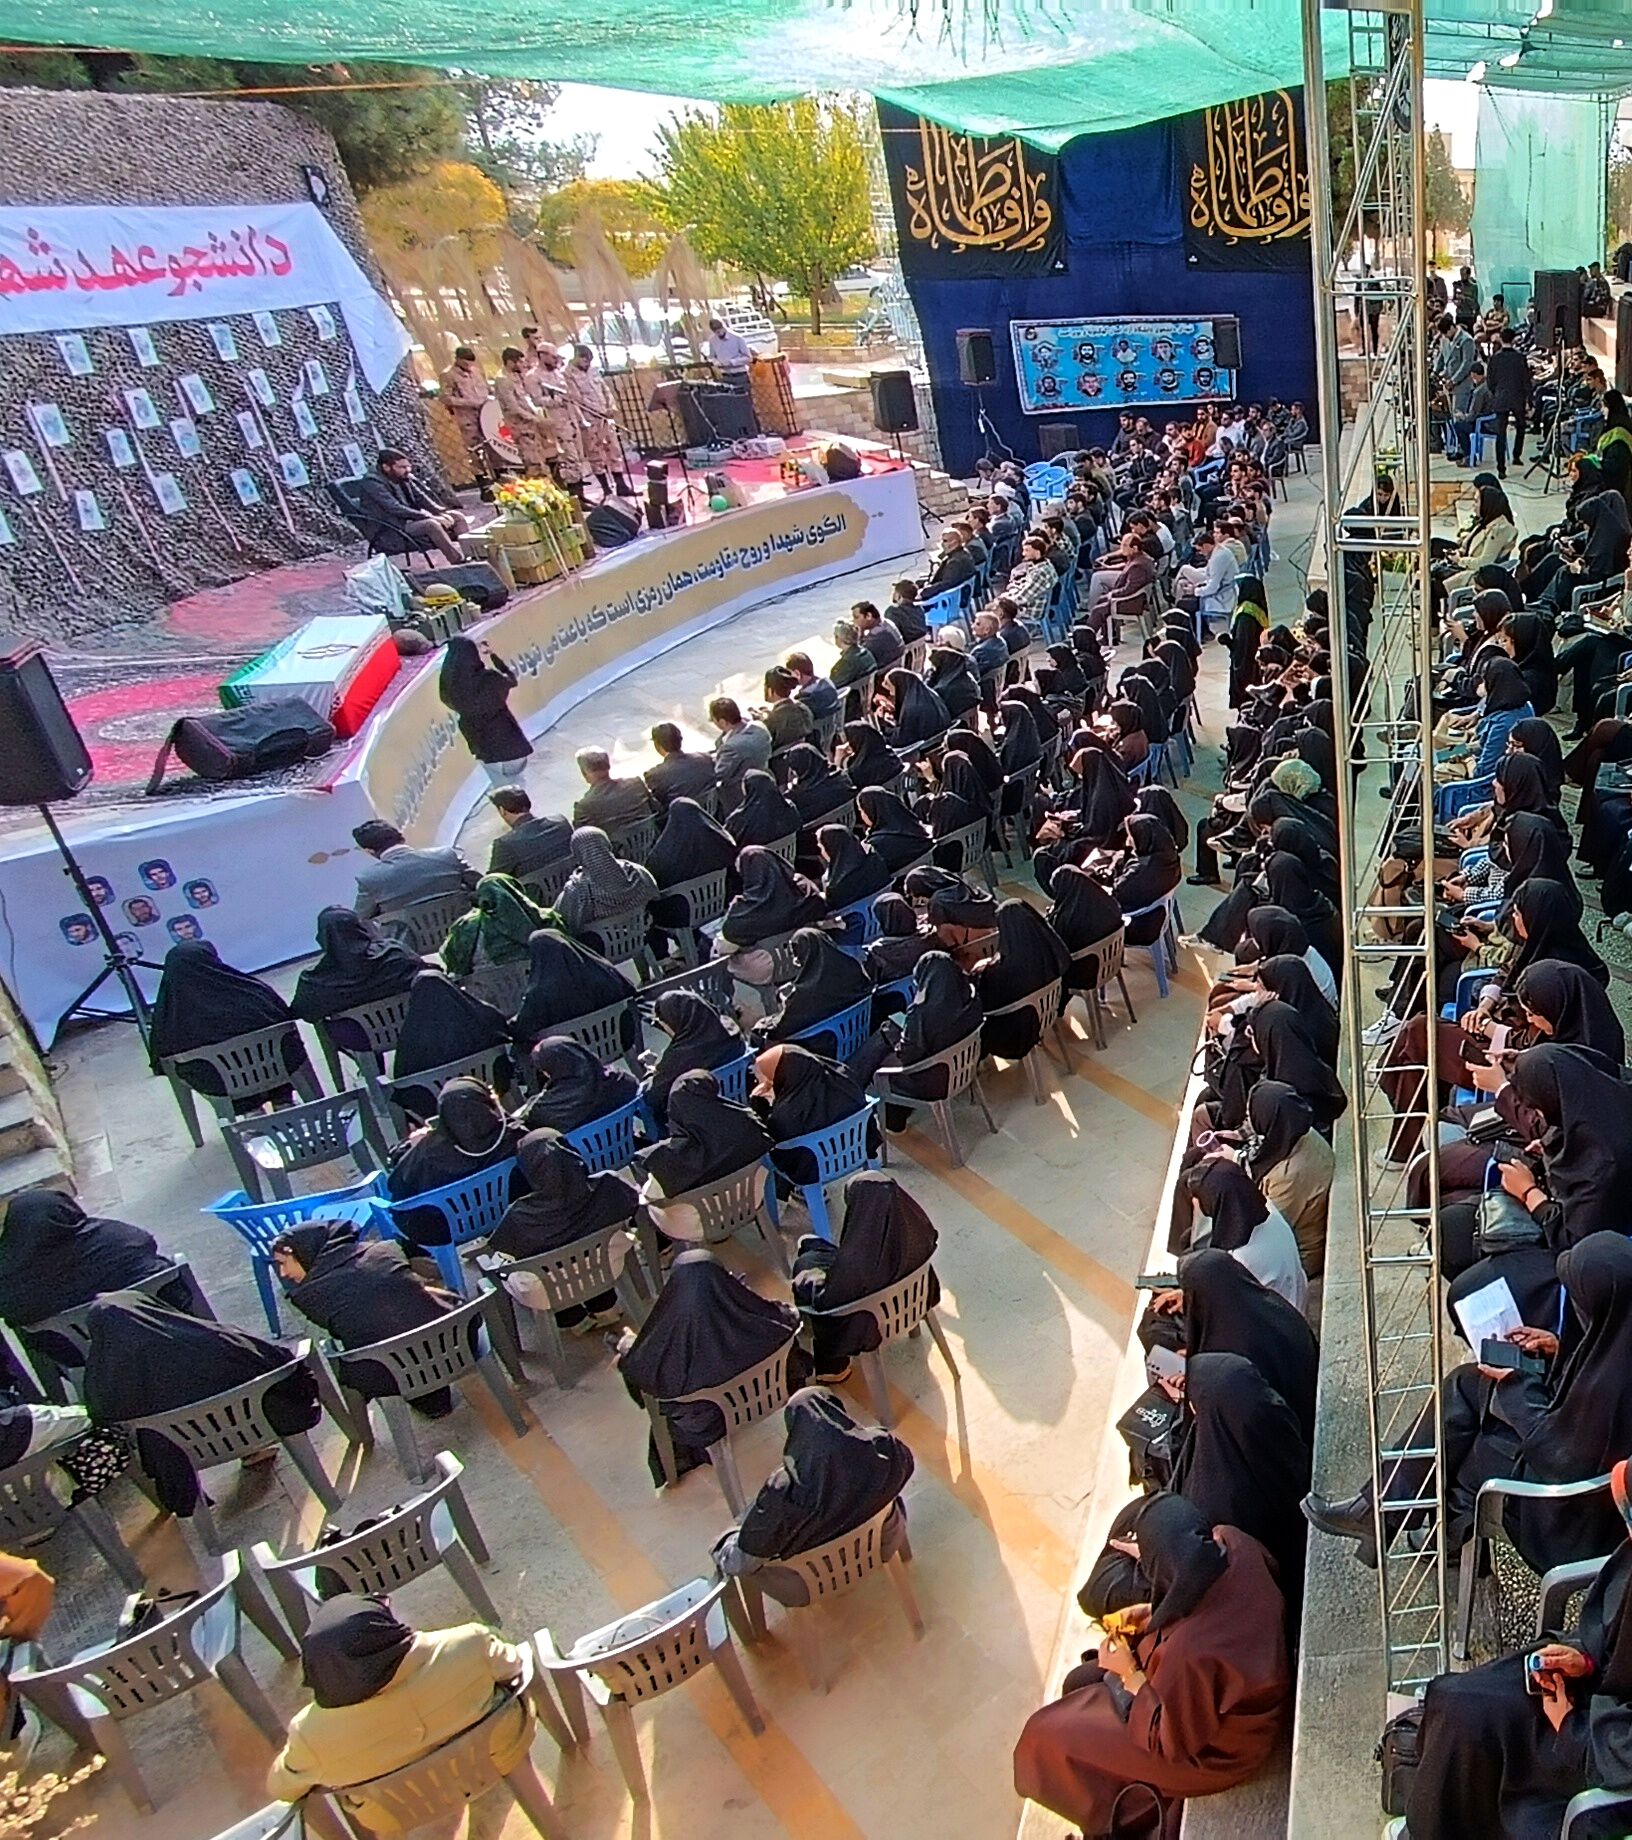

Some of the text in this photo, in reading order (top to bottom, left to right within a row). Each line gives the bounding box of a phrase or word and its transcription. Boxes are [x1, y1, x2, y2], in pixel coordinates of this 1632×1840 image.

[0, 225, 291, 297] دانشجو عهد شه
[770, 524, 804, 552] شهدا
[806, 513, 846, 546] الگوی
[741, 545, 763, 568] روح
[763, 542, 771, 560] و
[663, 572, 694, 599] همان
[607, 592, 636, 622] است
[636, 587, 663, 614] رمزی
[587, 606, 607, 631] که
